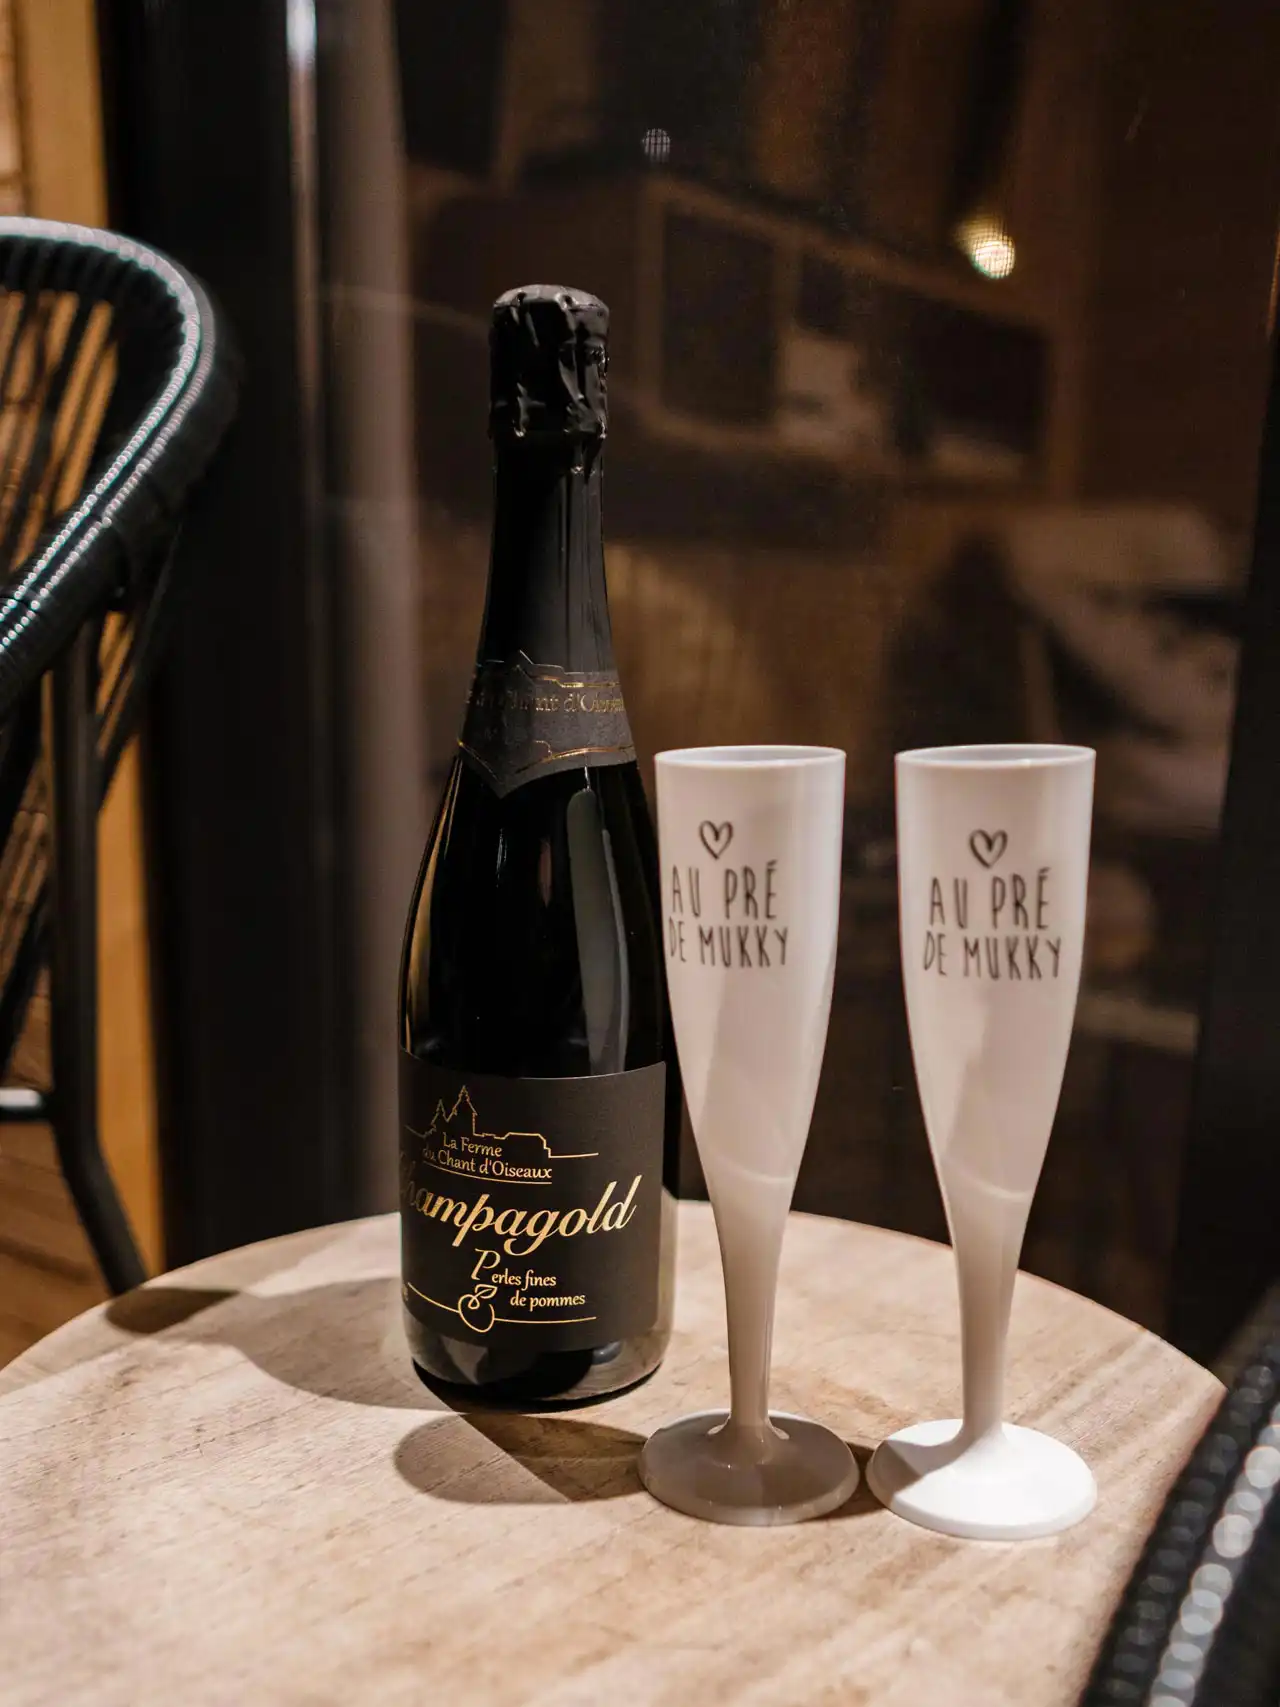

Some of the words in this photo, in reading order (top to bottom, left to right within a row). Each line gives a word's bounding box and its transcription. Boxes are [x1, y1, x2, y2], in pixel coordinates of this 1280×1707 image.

[672, 865, 700, 918] AU
[724, 859, 777, 920] PRÉ
[930, 876, 968, 929] AU
[992, 867, 1051, 930] PRÉ
[669, 916, 686, 962] DE
[699, 925, 788, 968] MUKKY
[923, 930, 947, 976] DE
[963, 934, 1062, 980] MUKKY
[422, 1143, 437, 1163] du
[438, 1150, 476, 1172] Chant
[479, 1160, 553, 1179] d'Oiseaux
[443, 1132, 458, 1150] La
[461, 1136, 502, 1157] Ferme
[510, 1289, 527, 1307] de
[529, 1294, 586, 1312] pommes
[522, 1269, 557, 1291] fines
